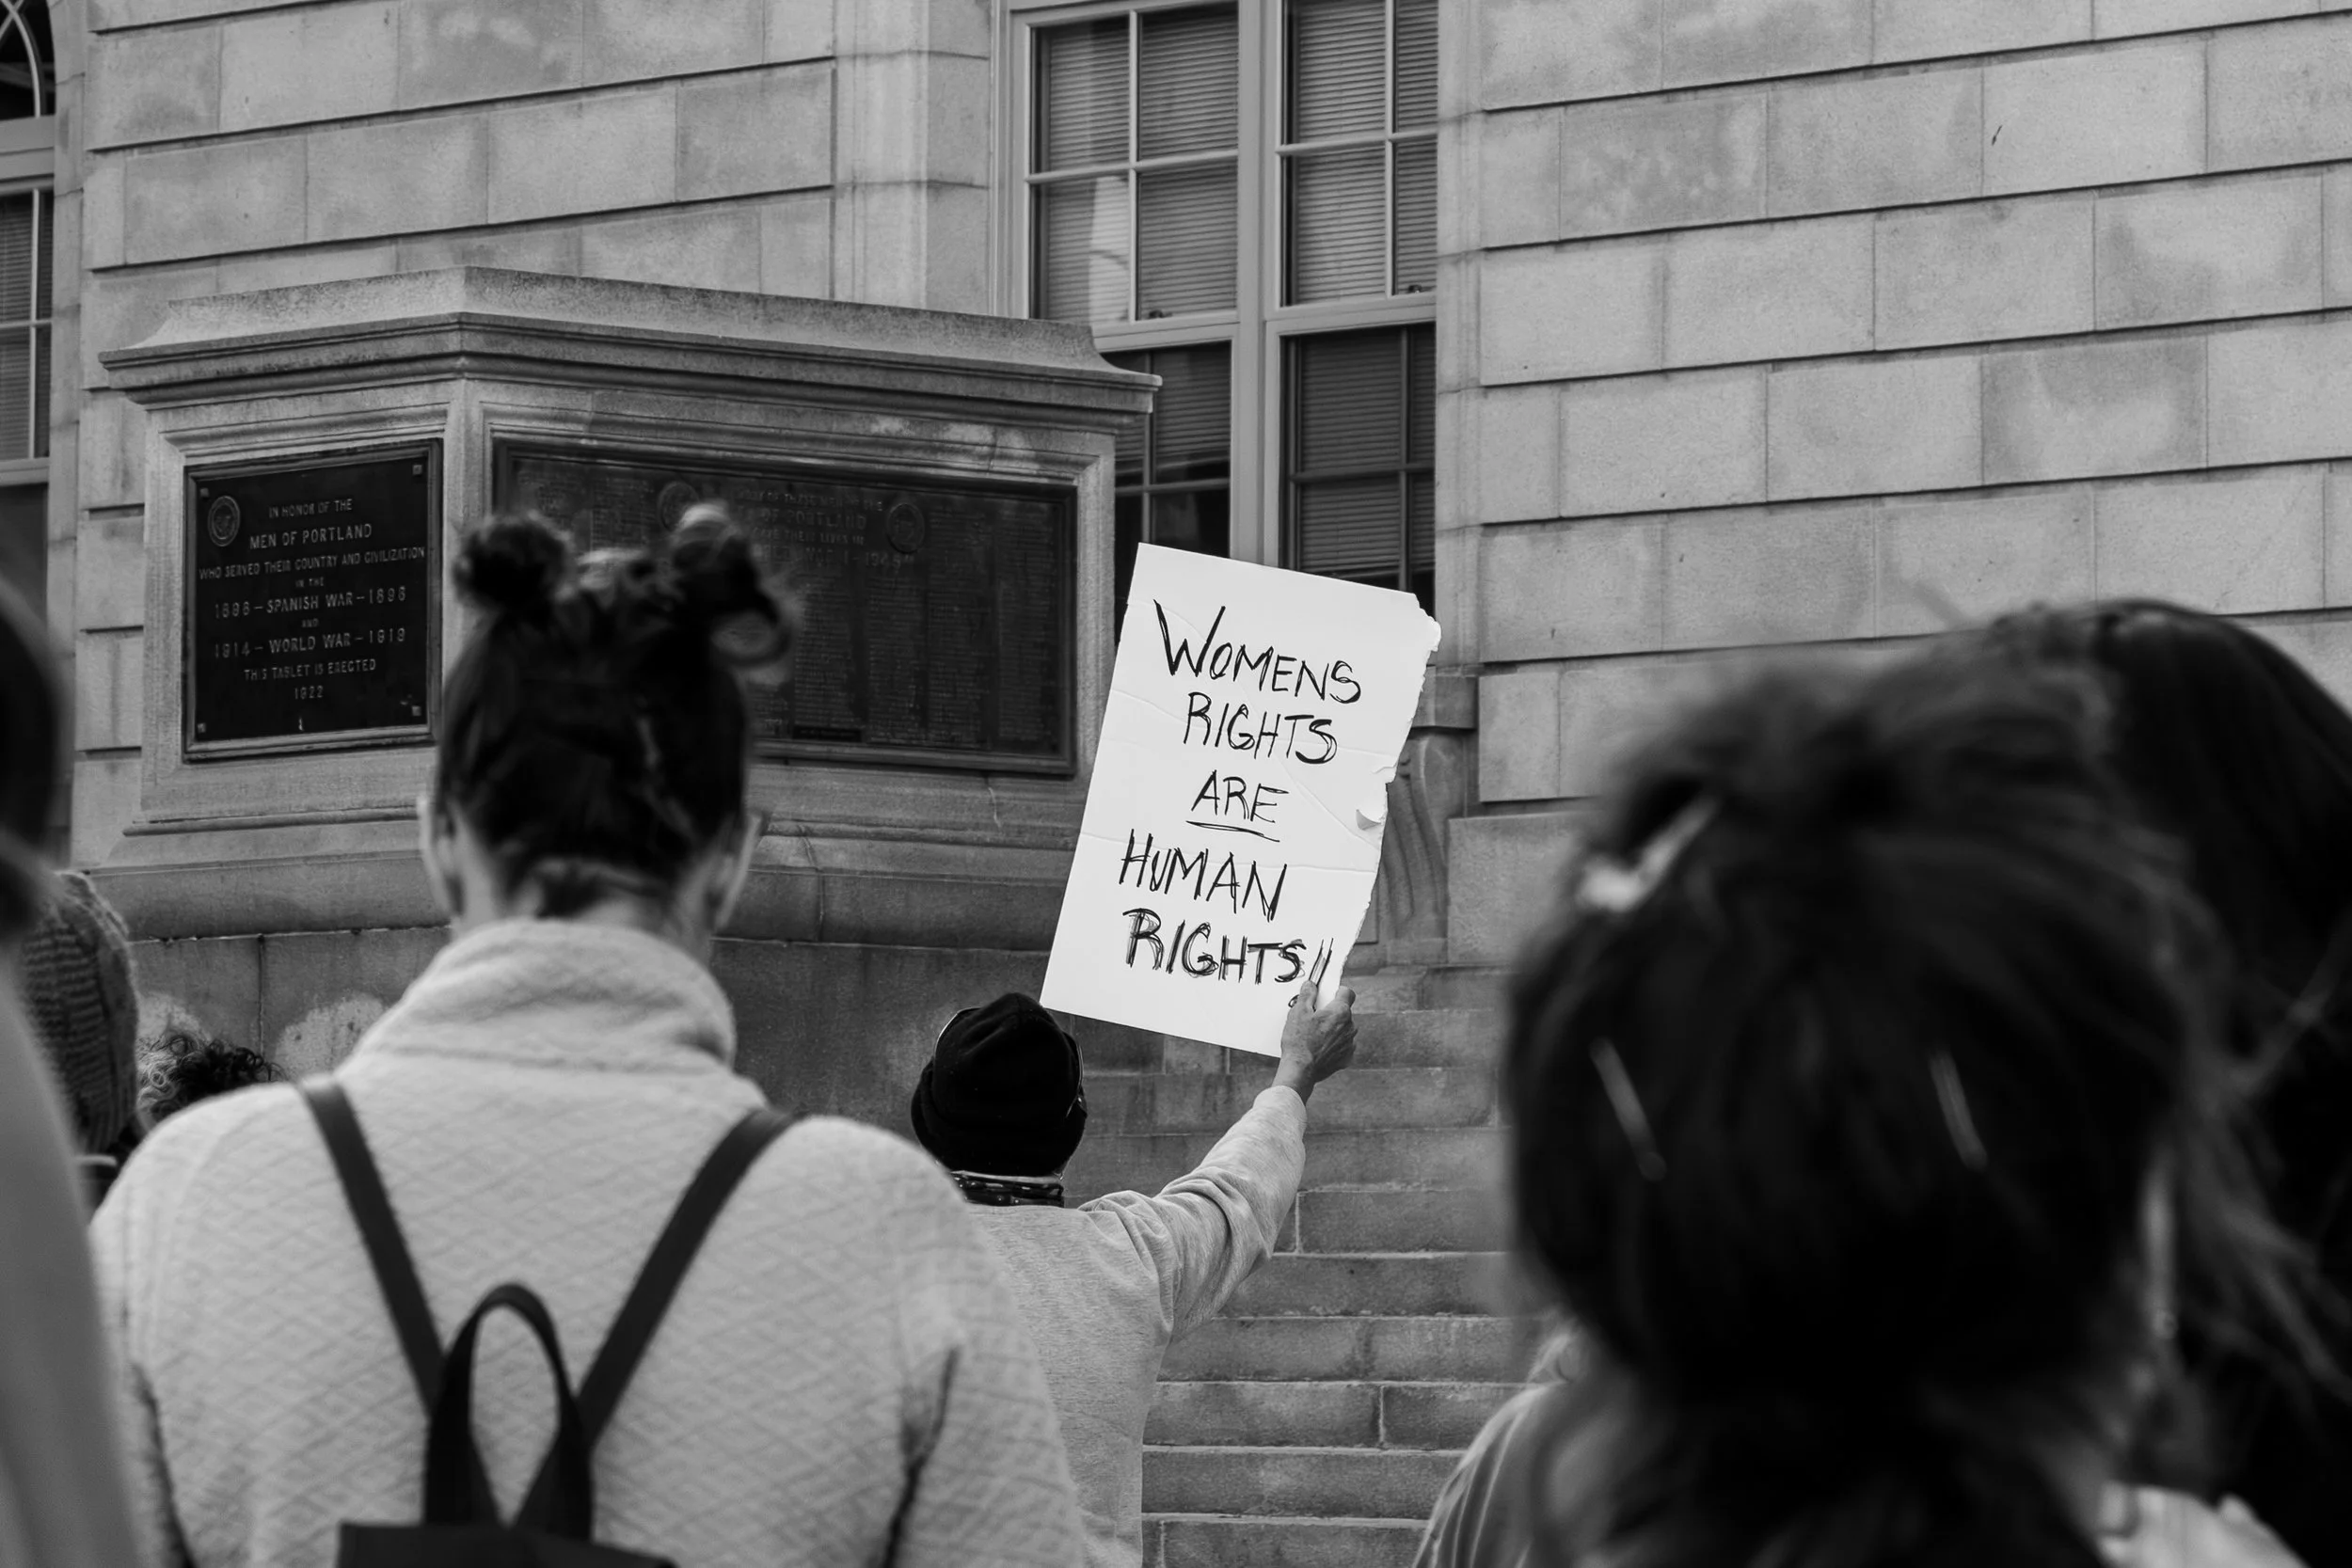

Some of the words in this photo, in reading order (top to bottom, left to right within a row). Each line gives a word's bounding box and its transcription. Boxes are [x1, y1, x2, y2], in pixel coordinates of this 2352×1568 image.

[268, 506, 278, 518] IN
[281, 503, 314, 517] HONOR
[318, 501, 330, 514] OF
[334, 499, 353, 512] THE
[249, 532, 277, 550] MEN
[281, 531, 297, 546] OF
[302, 523, 373, 545] PORTLAND
[199, 566, 222, 580] WHO
[225, 562, 261, 578] SERVED
[264, 560, 292, 575] THEIR
[294, 555, 338, 571] COUNTRY
[342, 552, 361, 566] AND
[363, 546, 426, 564] CIVILIZATION
[301, 618, 320, 628] AND
[268, 635, 316, 654] WORLD
[323, 632, 352, 649] WAR
[1152, 599, 1361, 704] WOMENS
[245, 668, 267, 681] THIS
[271, 663, 310, 680] TABLET
[314, 662, 325, 676] IS
[327, 658, 376, 675] ERECTED
[294, 685, 324, 701] 1922
[1183, 691, 1338, 765] RIGHTS
[1190, 769, 1290, 824] ARE
[1118, 828, 1287, 922] HUMAN
